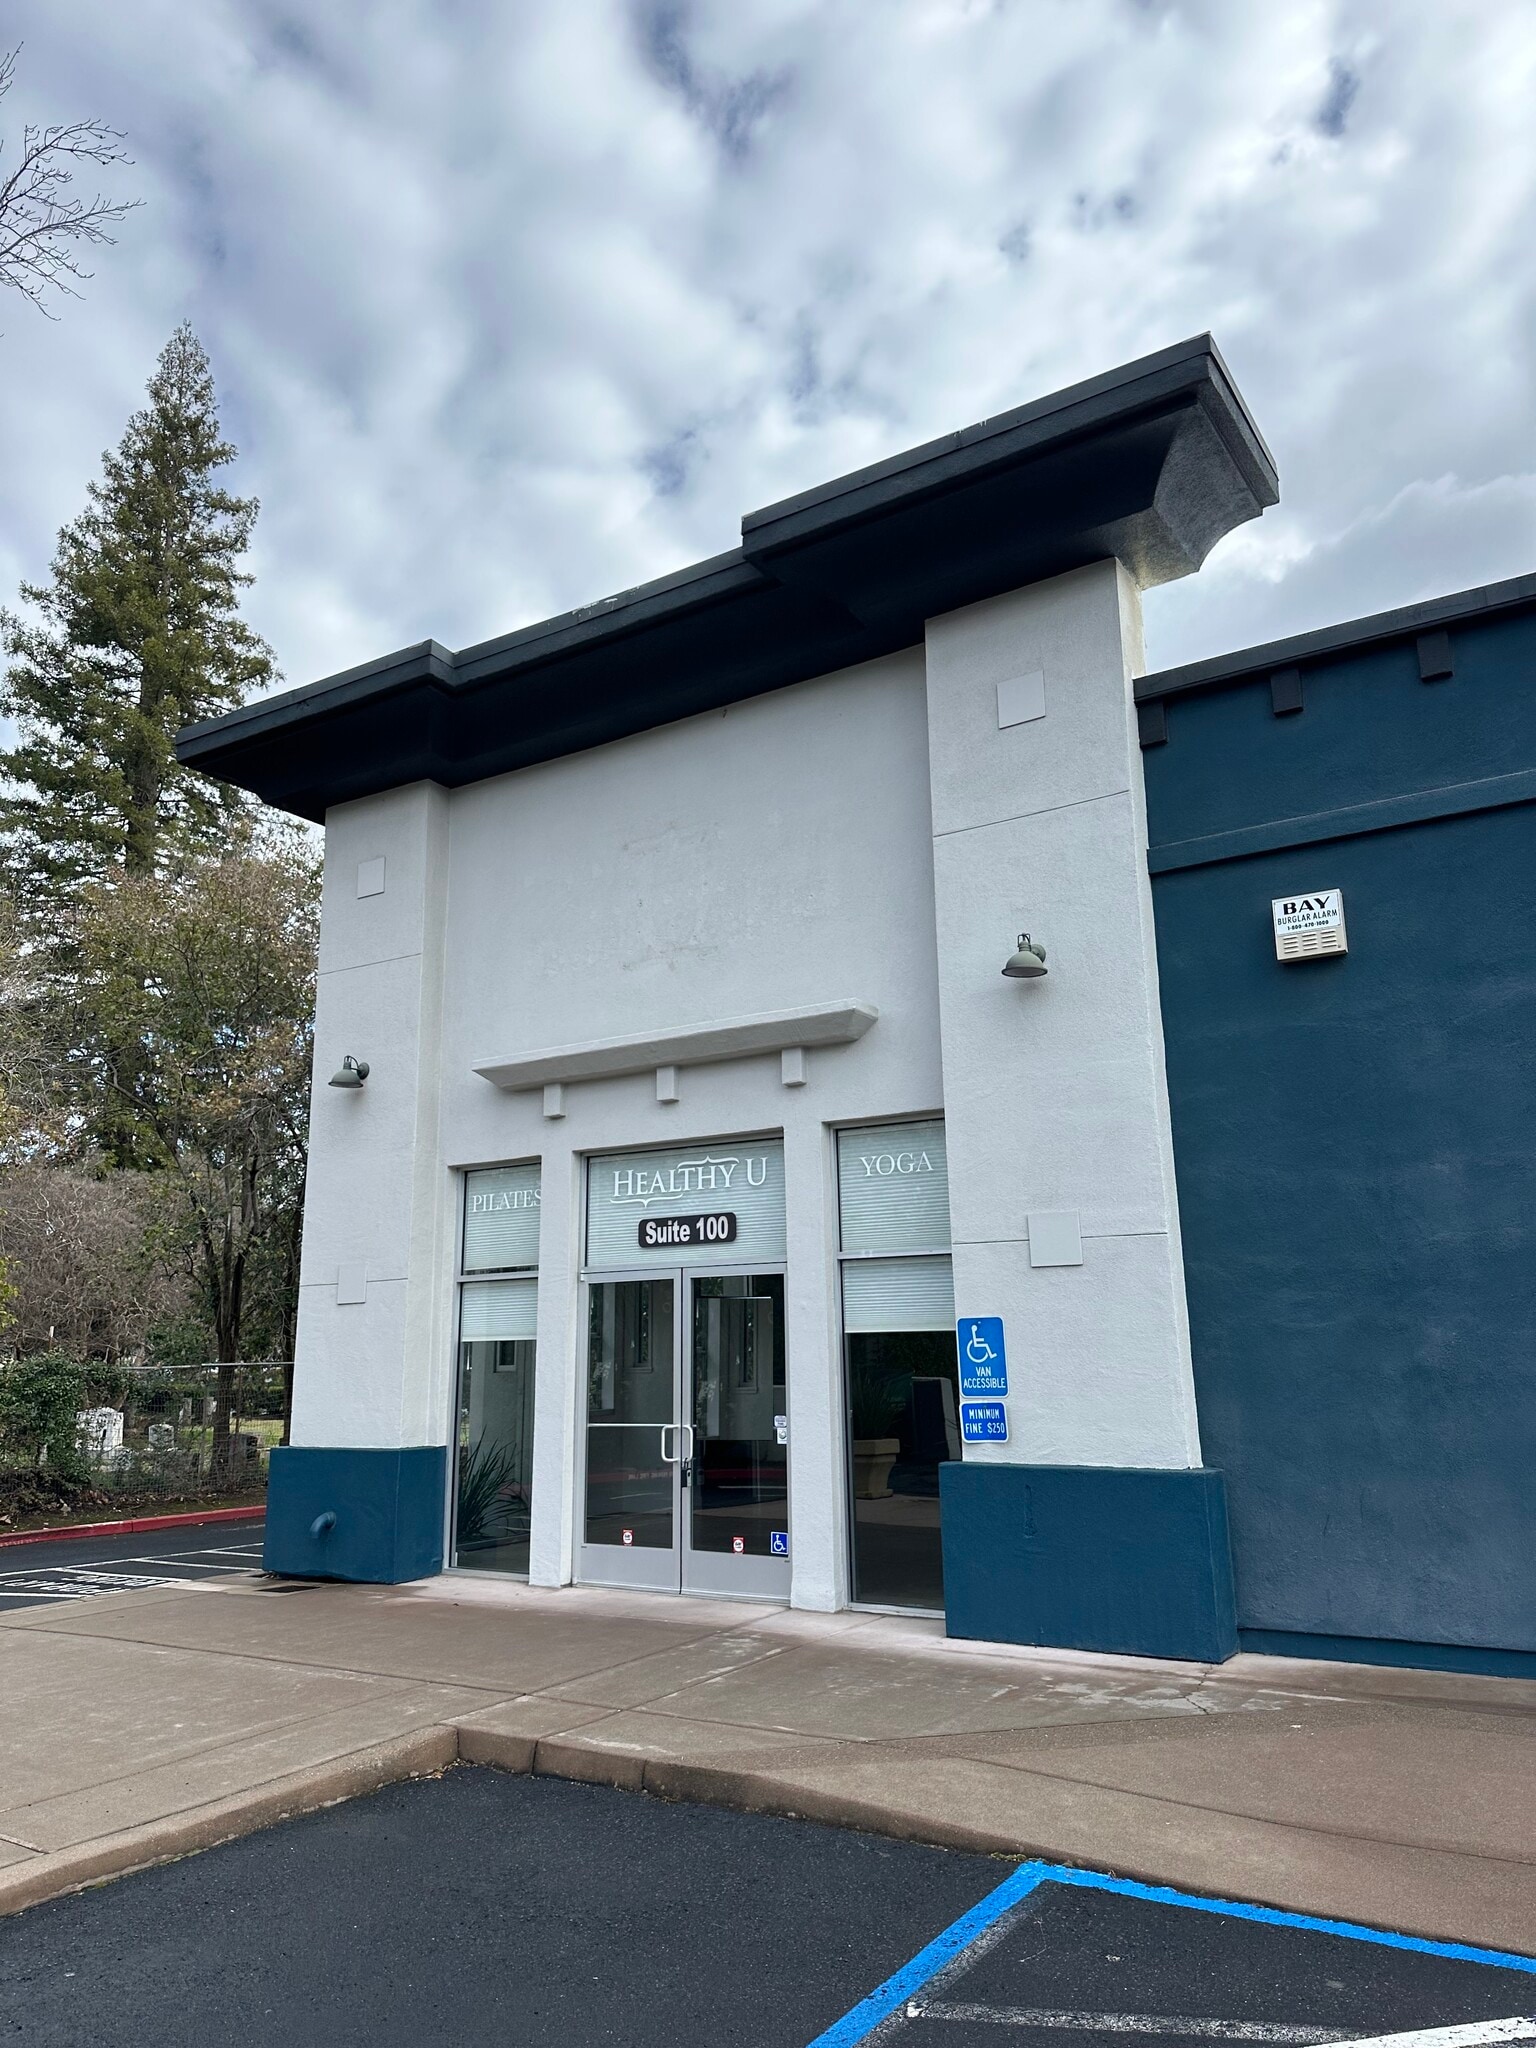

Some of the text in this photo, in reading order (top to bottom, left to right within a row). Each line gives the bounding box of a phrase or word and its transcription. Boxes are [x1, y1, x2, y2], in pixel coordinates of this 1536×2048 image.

[1283, 896, 1330, 915] BAY
[1277, 909, 1338, 926] BURGLAR ALARM
[746, 1157, 768, 1186] U
[859, 1151, 934, 1177] YOGA
[645, 1216, 729, 1244] Suite 100
[975, 1366, 992, 1377] VAN
[963, 1378, 1006, 1389] ACCESSIBLE
[968, 1408, 1000, 1420] MINIMUM
[965, 1422, 1005, 1434] FINE $250
